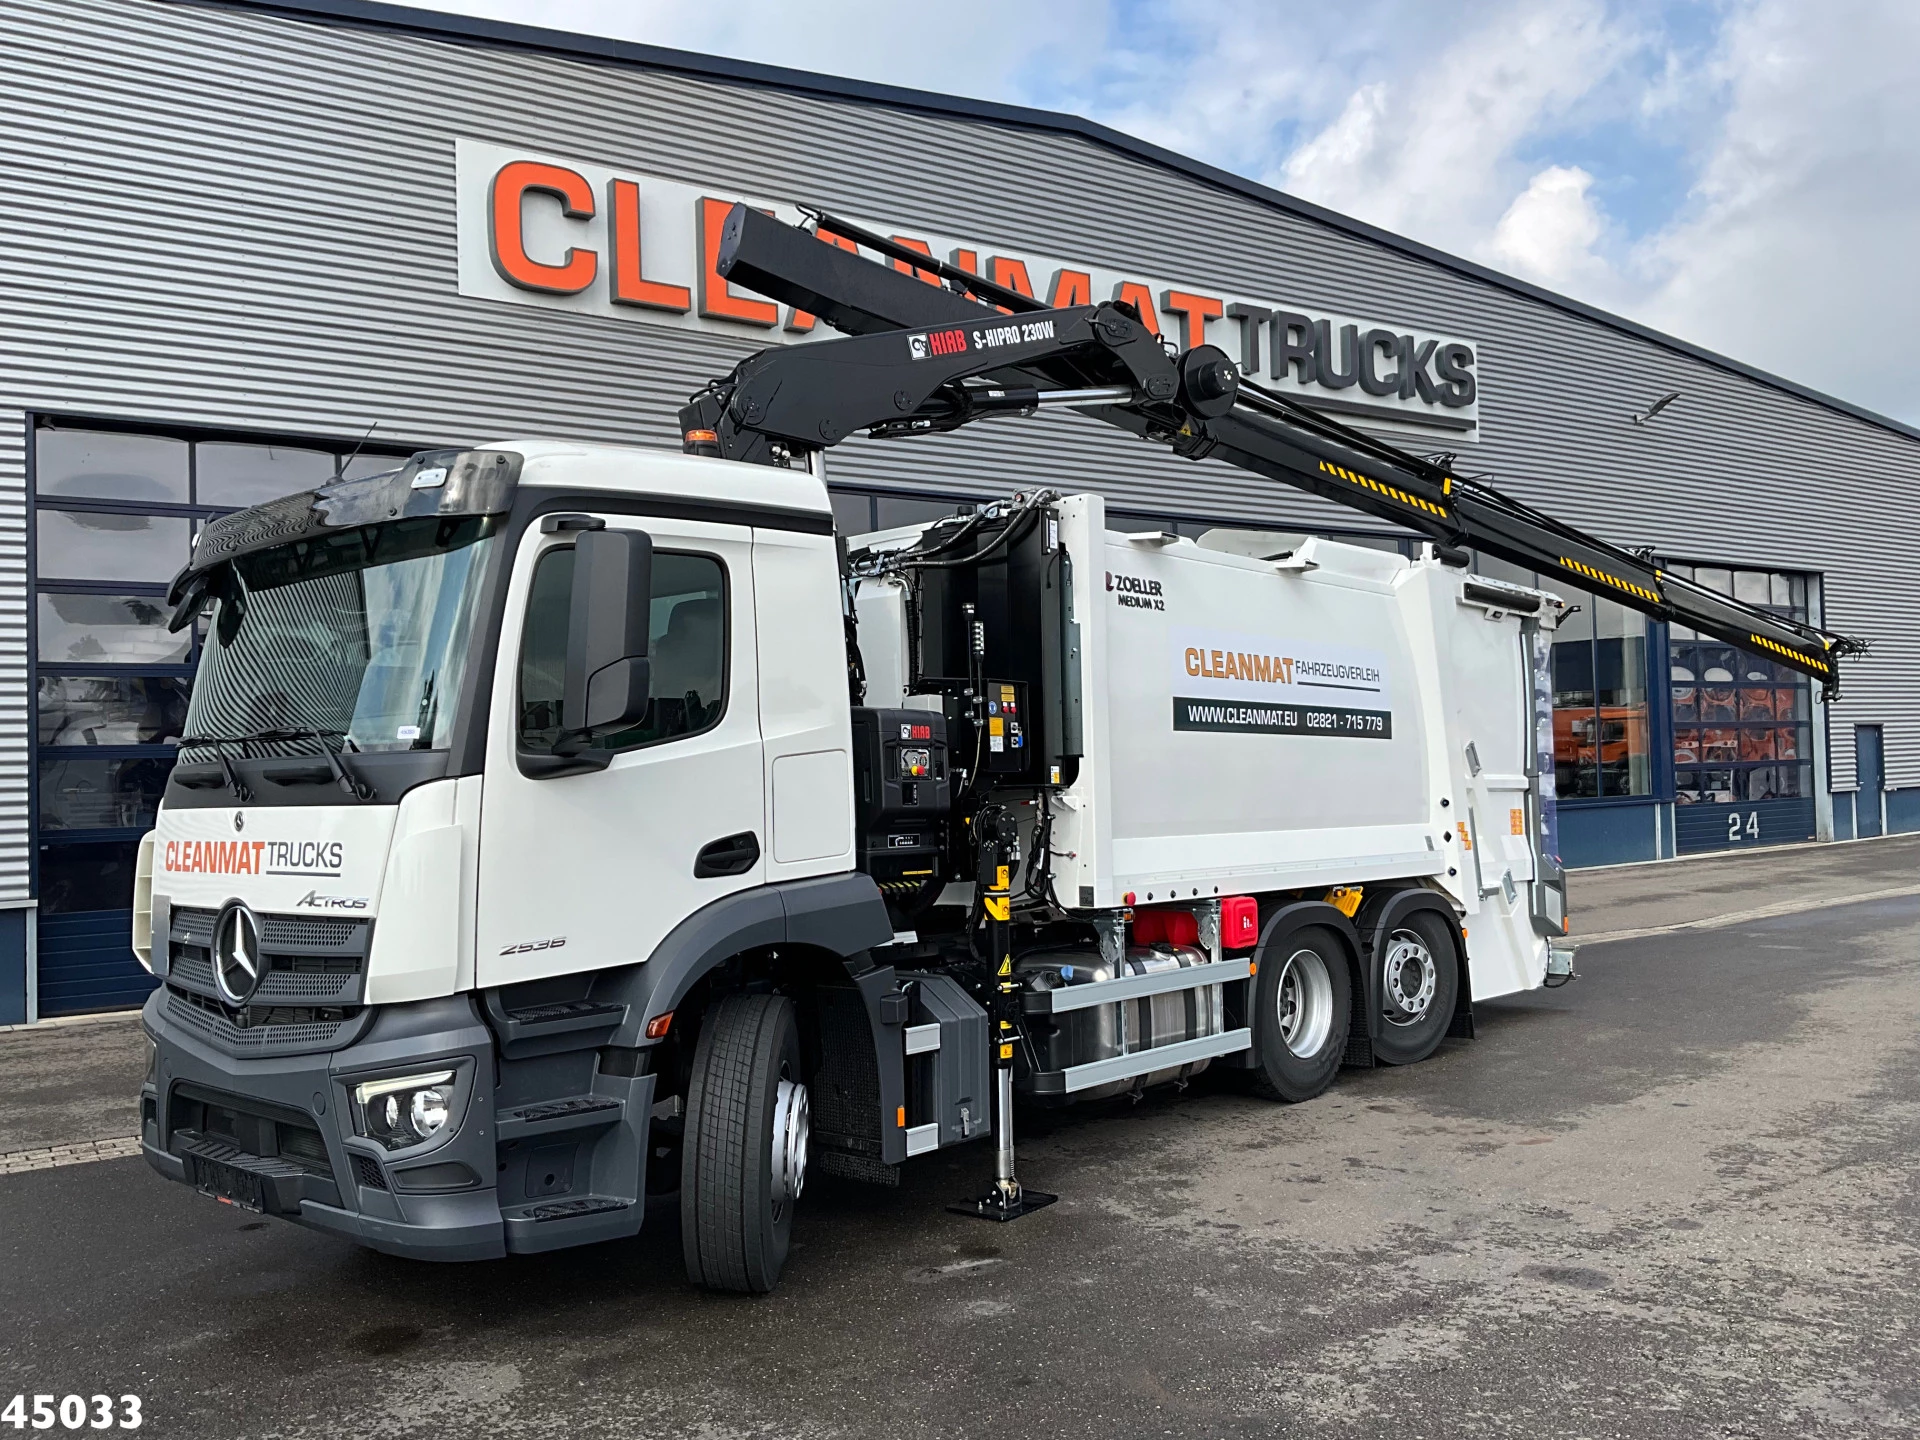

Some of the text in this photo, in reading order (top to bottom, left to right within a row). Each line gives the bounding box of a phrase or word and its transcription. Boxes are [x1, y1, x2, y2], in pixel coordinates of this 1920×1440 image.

[487, 160, 1476, 408] CLEAT TRUCKS
[929, 320, 1055, 355] HIAB S-HIPRO 230W
[1115, 575, 1162, 596] ZOELLER
[1118, 594, 1165, 611] MEDIUM X2
[1185, 648, 1380, 684] CLEANMAT FAHRZEUGVERLEIH
[912, 725, 931, 739] HIAB
[1188, 705, 1298, 726] WWW.CLEANMAT.EU
[1307, 712, 1337, 728] 02821
[1346, 715, 1363, 730] 715
[1365, 716, 1383, 731] 779
[1728, 811, 1759, 841] 24
[166, 841, 343, 874] CLEANMAT TRUCKS
[499, 937, 567, 956] 2536
